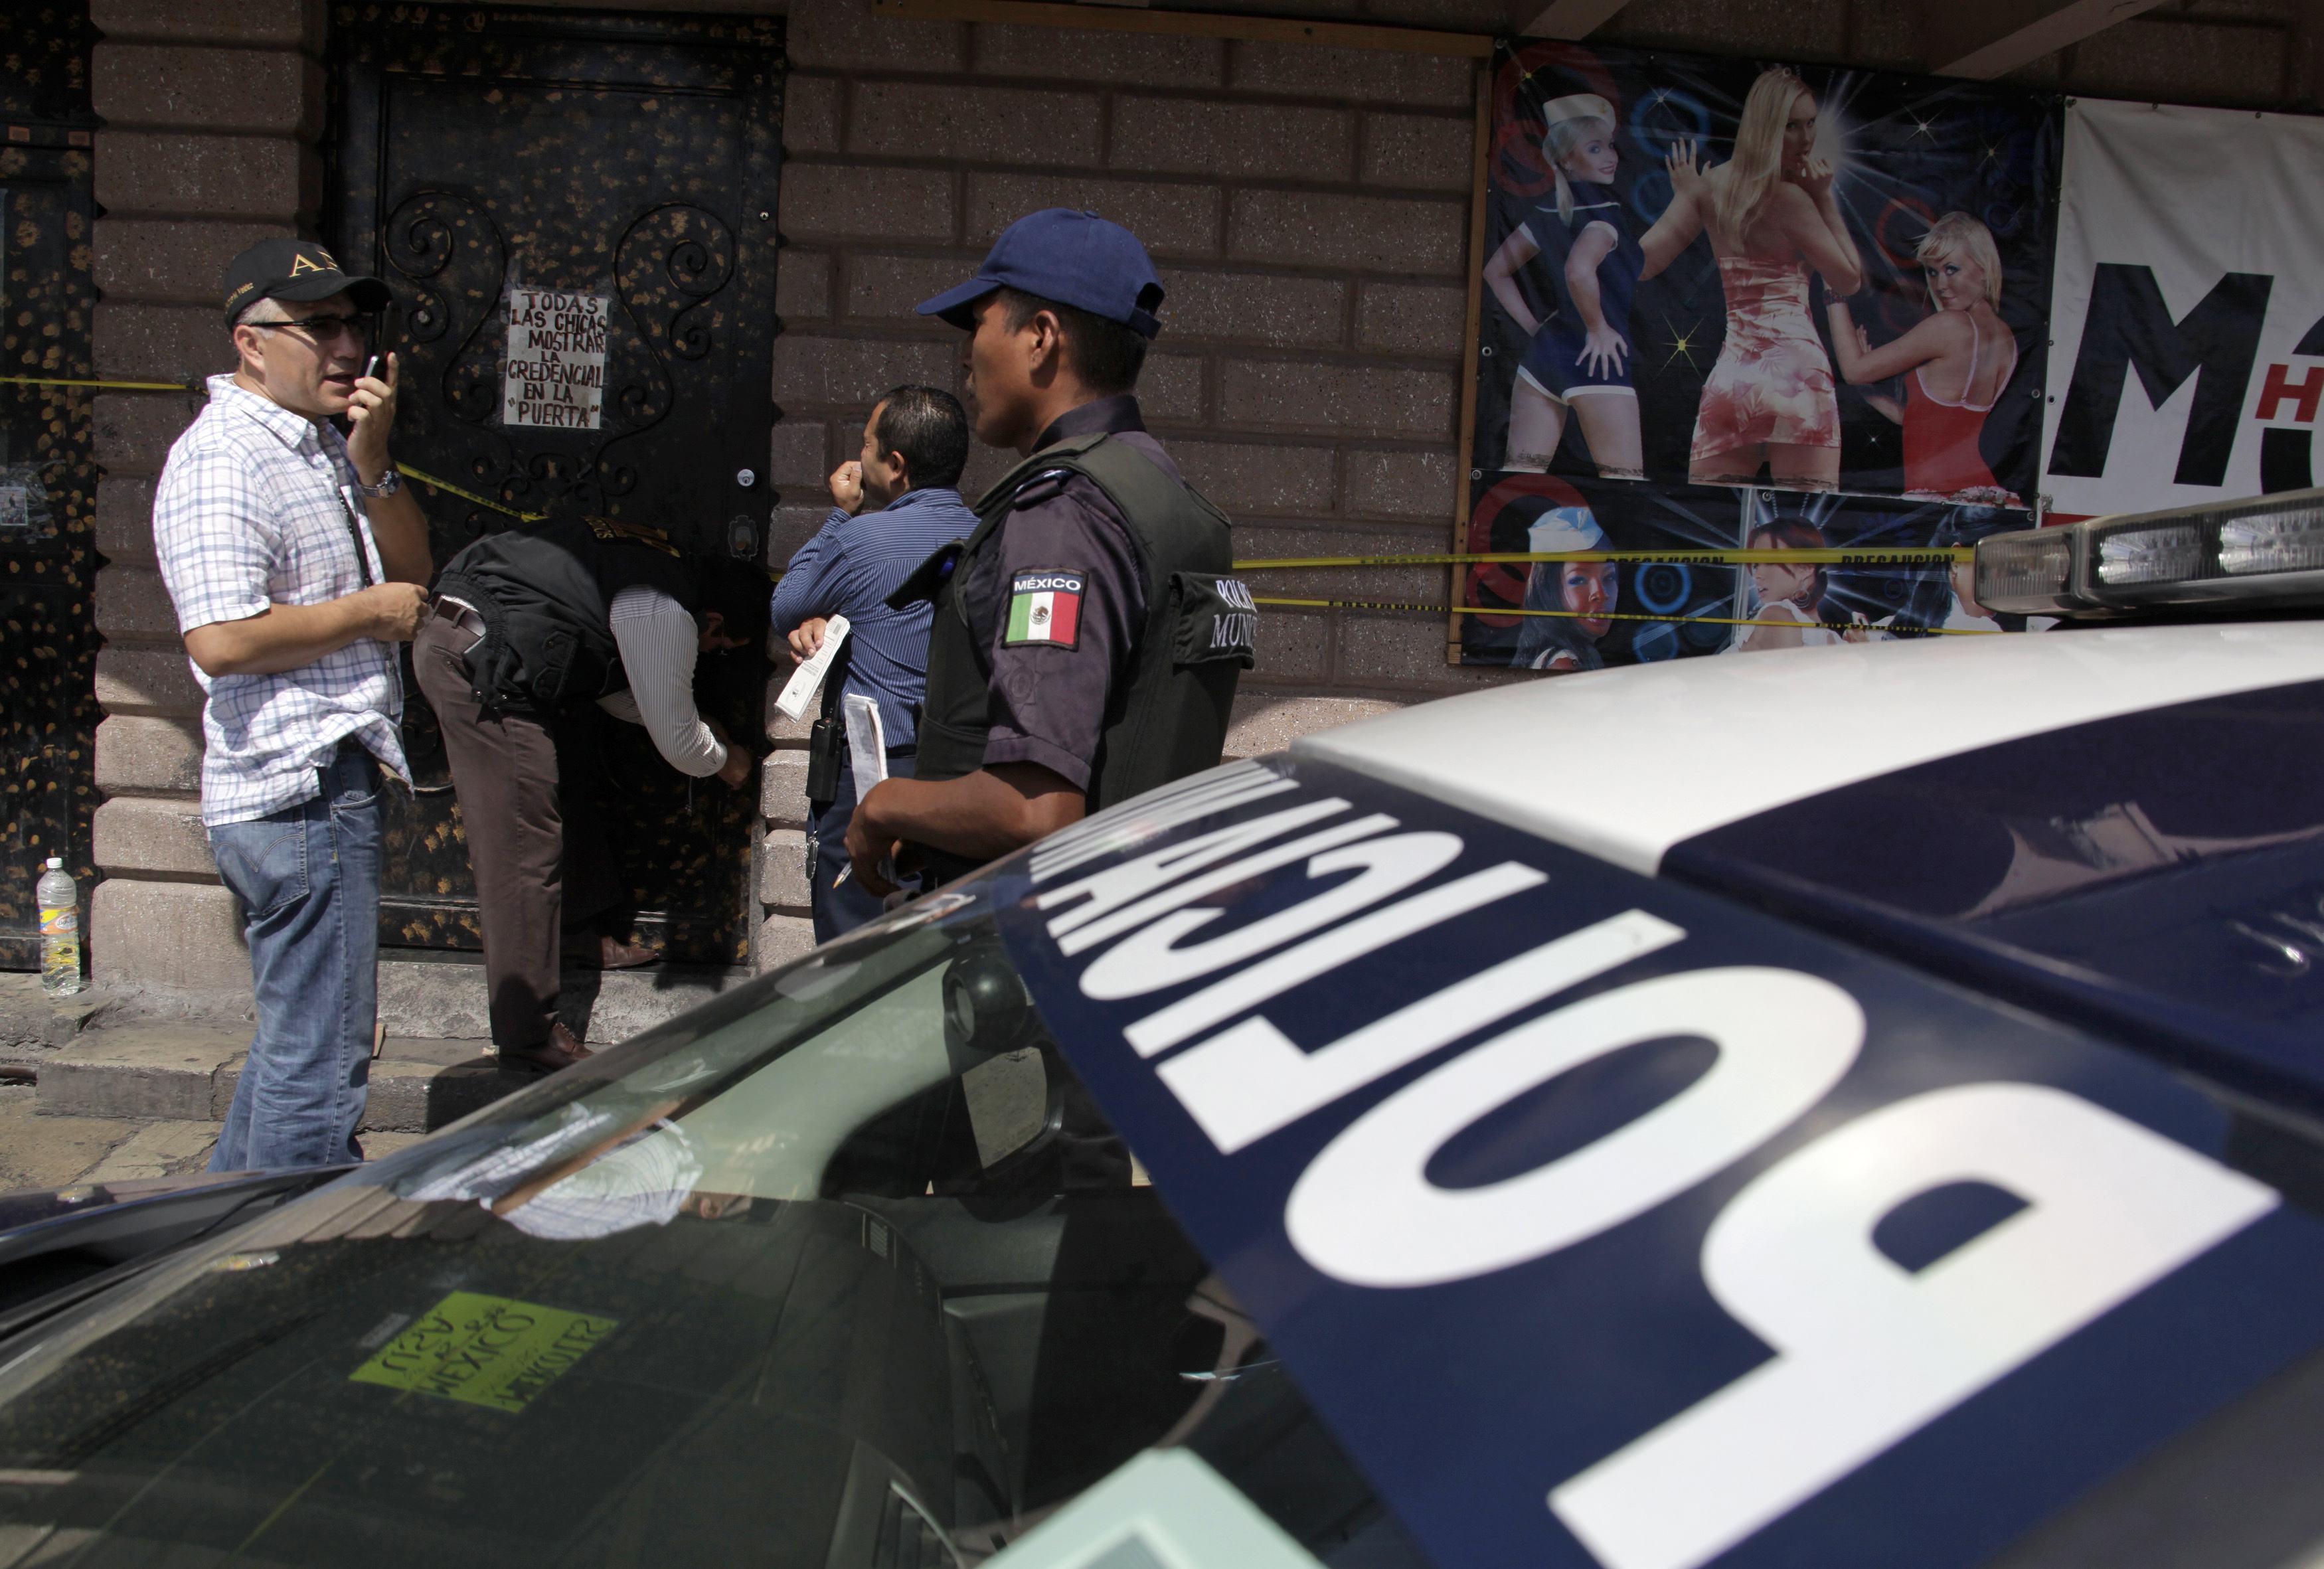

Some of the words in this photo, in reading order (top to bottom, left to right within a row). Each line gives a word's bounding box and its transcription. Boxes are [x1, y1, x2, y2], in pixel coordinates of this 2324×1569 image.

[521, 292, 598, 315] TODAS
[511, 309, 546, 328] LAS
[554, 313, 607, 335] CHICAS
[528, 330, 606, 353] MOSTRAR
[541, 351, 560, 363] LA
[507, 359, 603, 388] CREDENCIAL
[523, 382, 544, 400] EN
[553, 384, 573, 404] LA
[1014, 577, 1081, 591] MÉXICO
